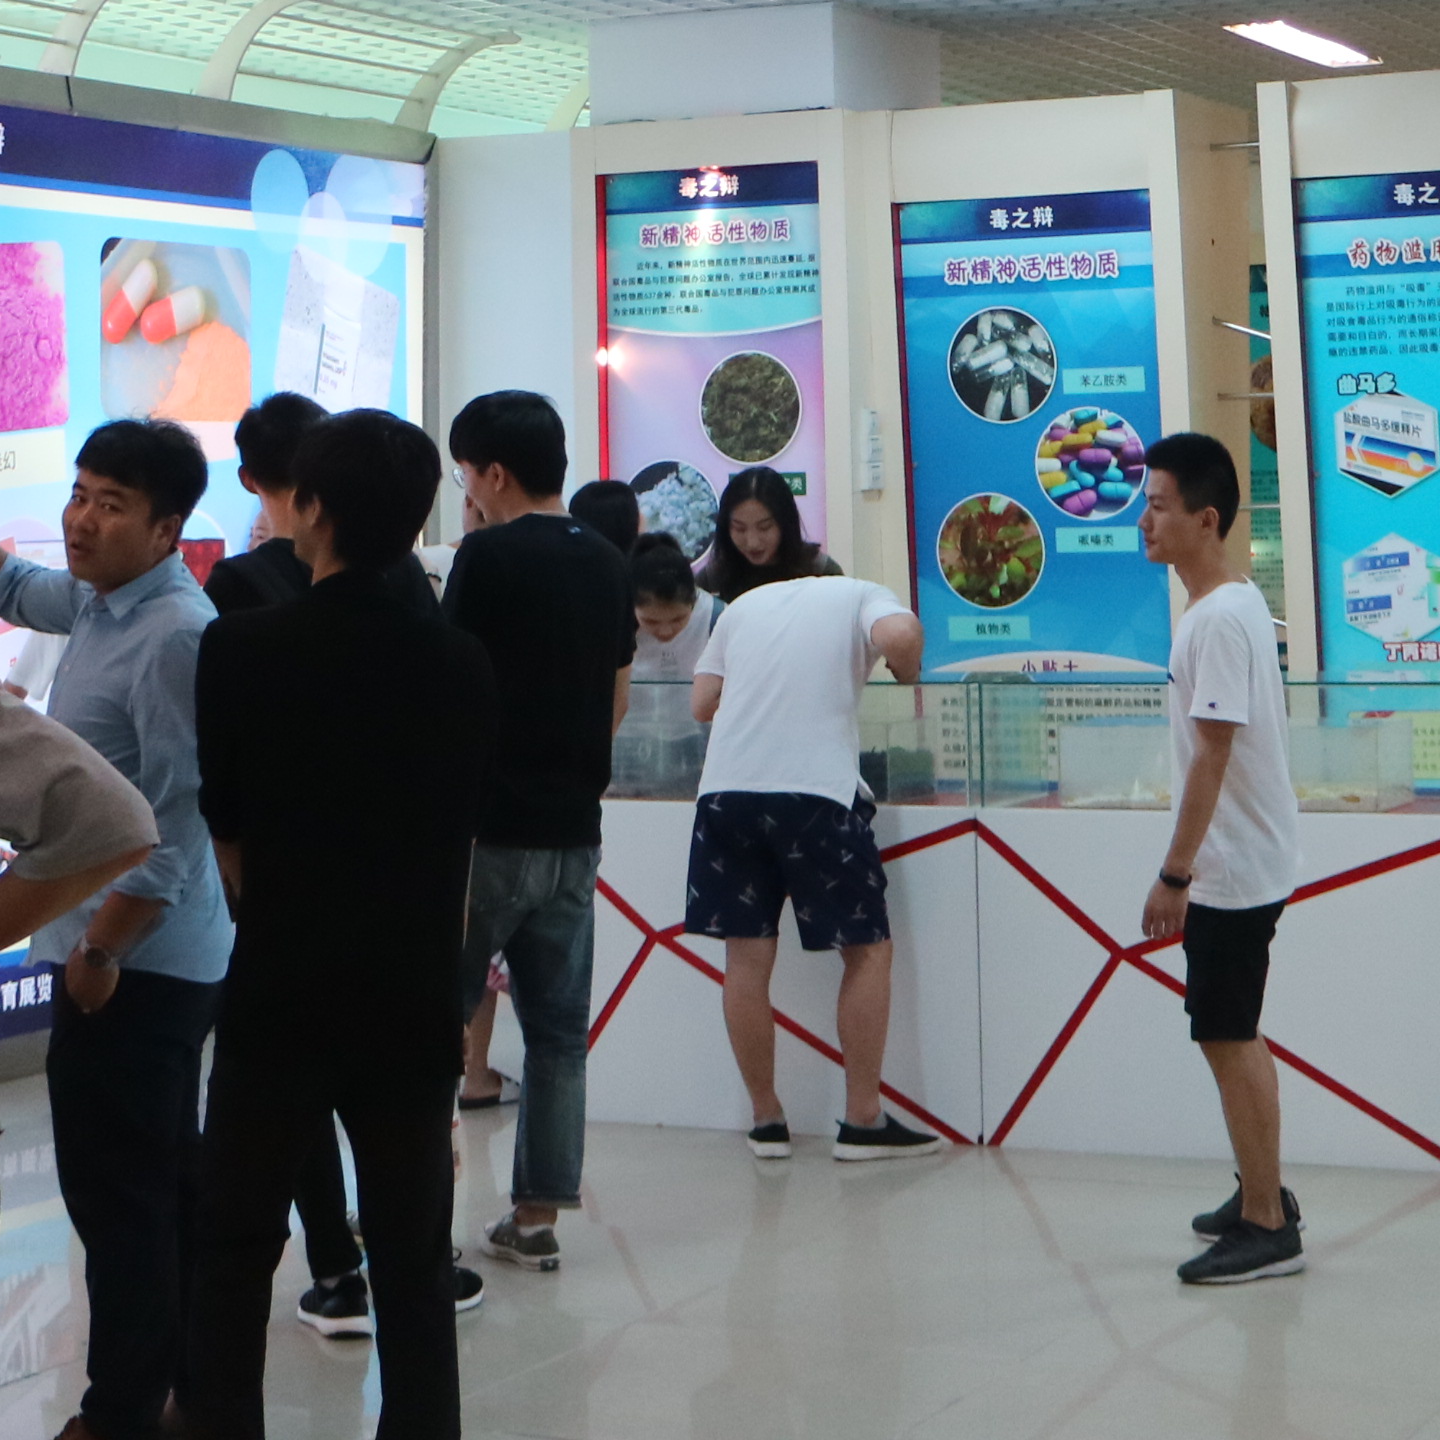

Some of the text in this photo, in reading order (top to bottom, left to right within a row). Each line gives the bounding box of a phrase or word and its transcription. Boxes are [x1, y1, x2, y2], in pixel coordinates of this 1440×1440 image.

[641, 220, 790, 247] 新精神活性物质
[945, 251, 1119, 284] 新精神活性物质
